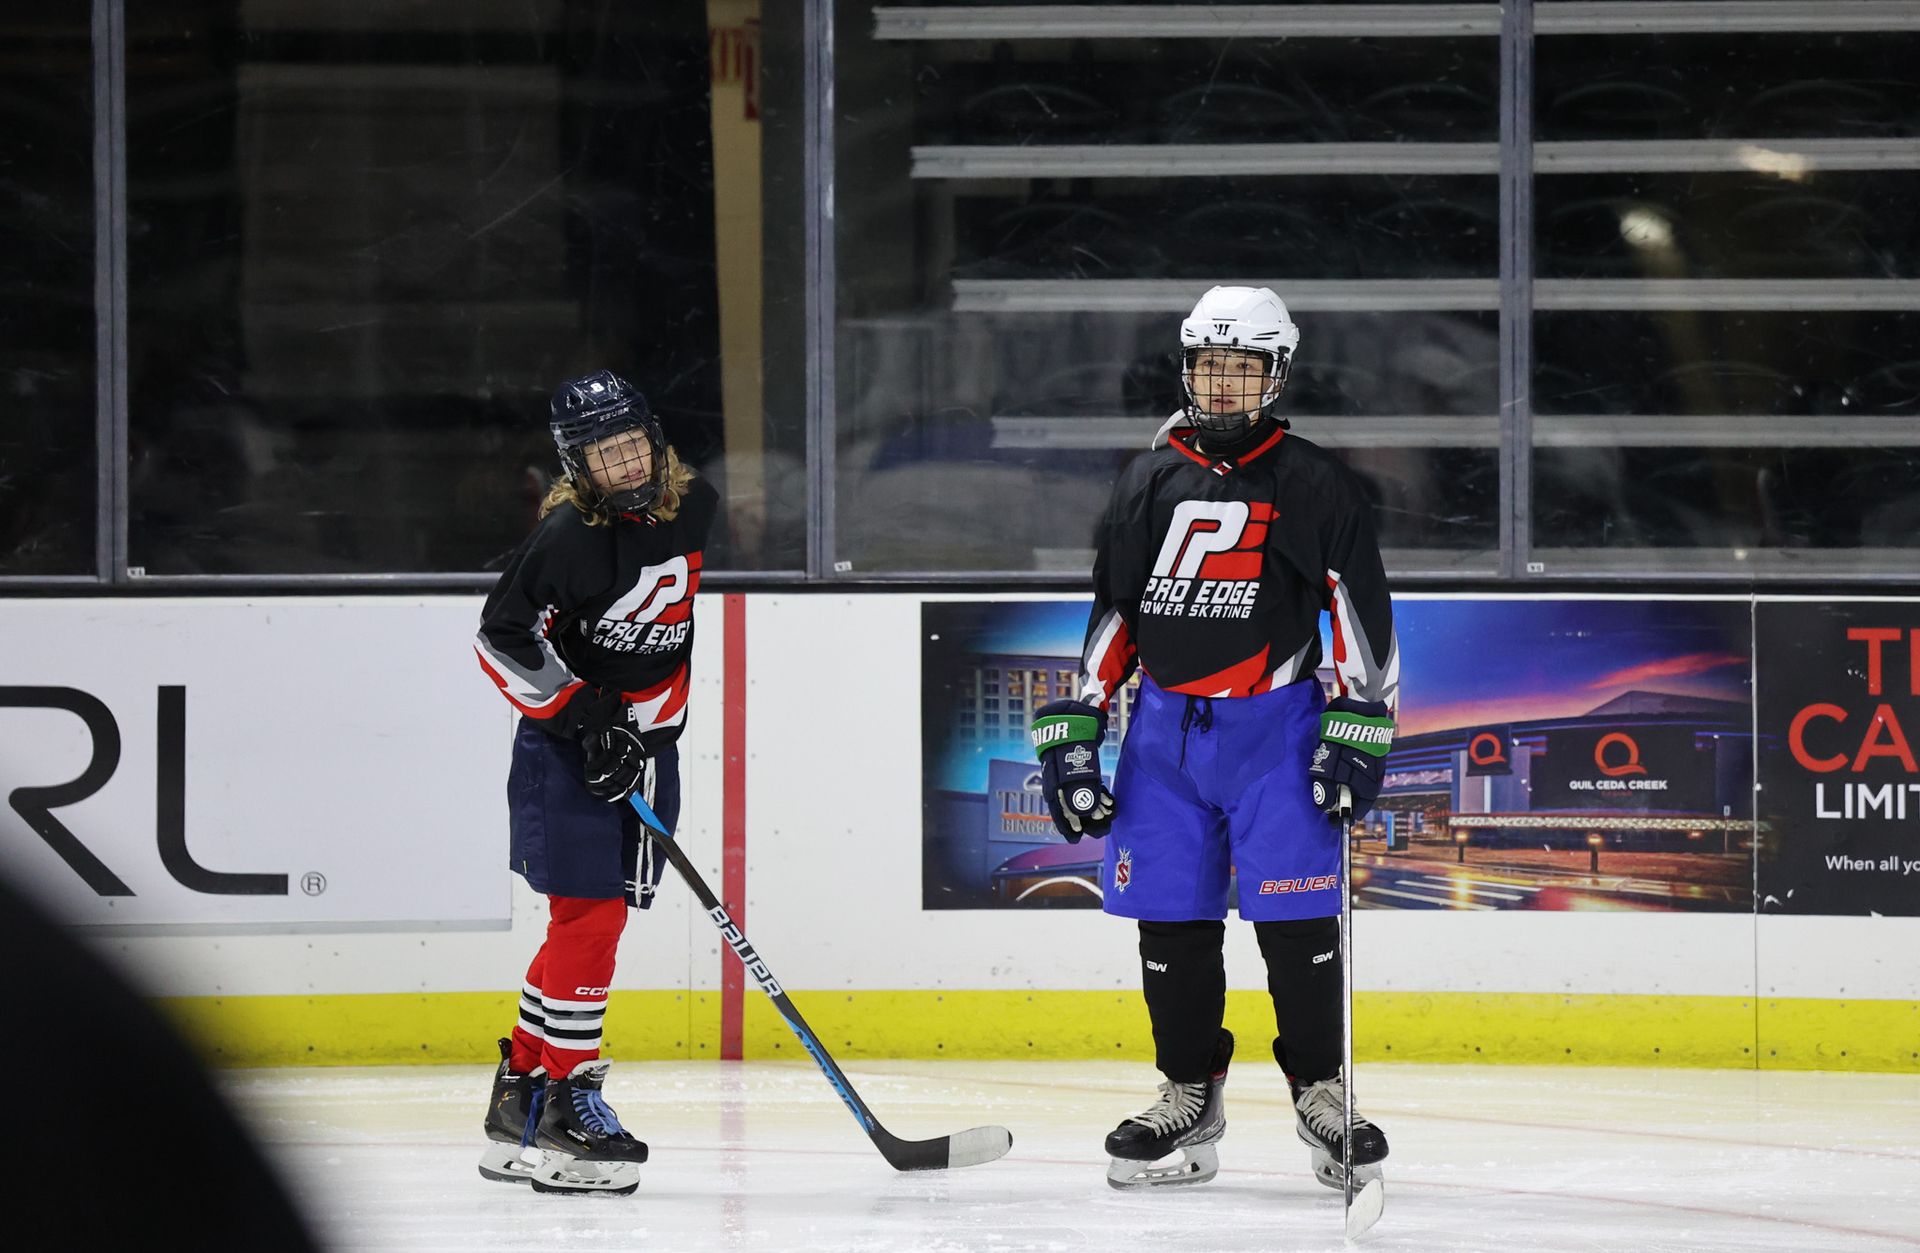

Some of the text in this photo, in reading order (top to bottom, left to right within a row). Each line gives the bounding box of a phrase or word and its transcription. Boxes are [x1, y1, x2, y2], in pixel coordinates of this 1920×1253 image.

[1143, 577, 1261, 605] PRO EDGE
[1140, 600, 1254, 619] POWER SKATING
[594, 619, 646, 642] PRO
[592, 634, 636, 653] OWER
[1788, 702, 1920, 774] CA
[1569, 780, 1668, 790] QUIL CEDA CREEK
[1825, 855, 1875, 871] When
[1879, 856, 1899, 871] all
